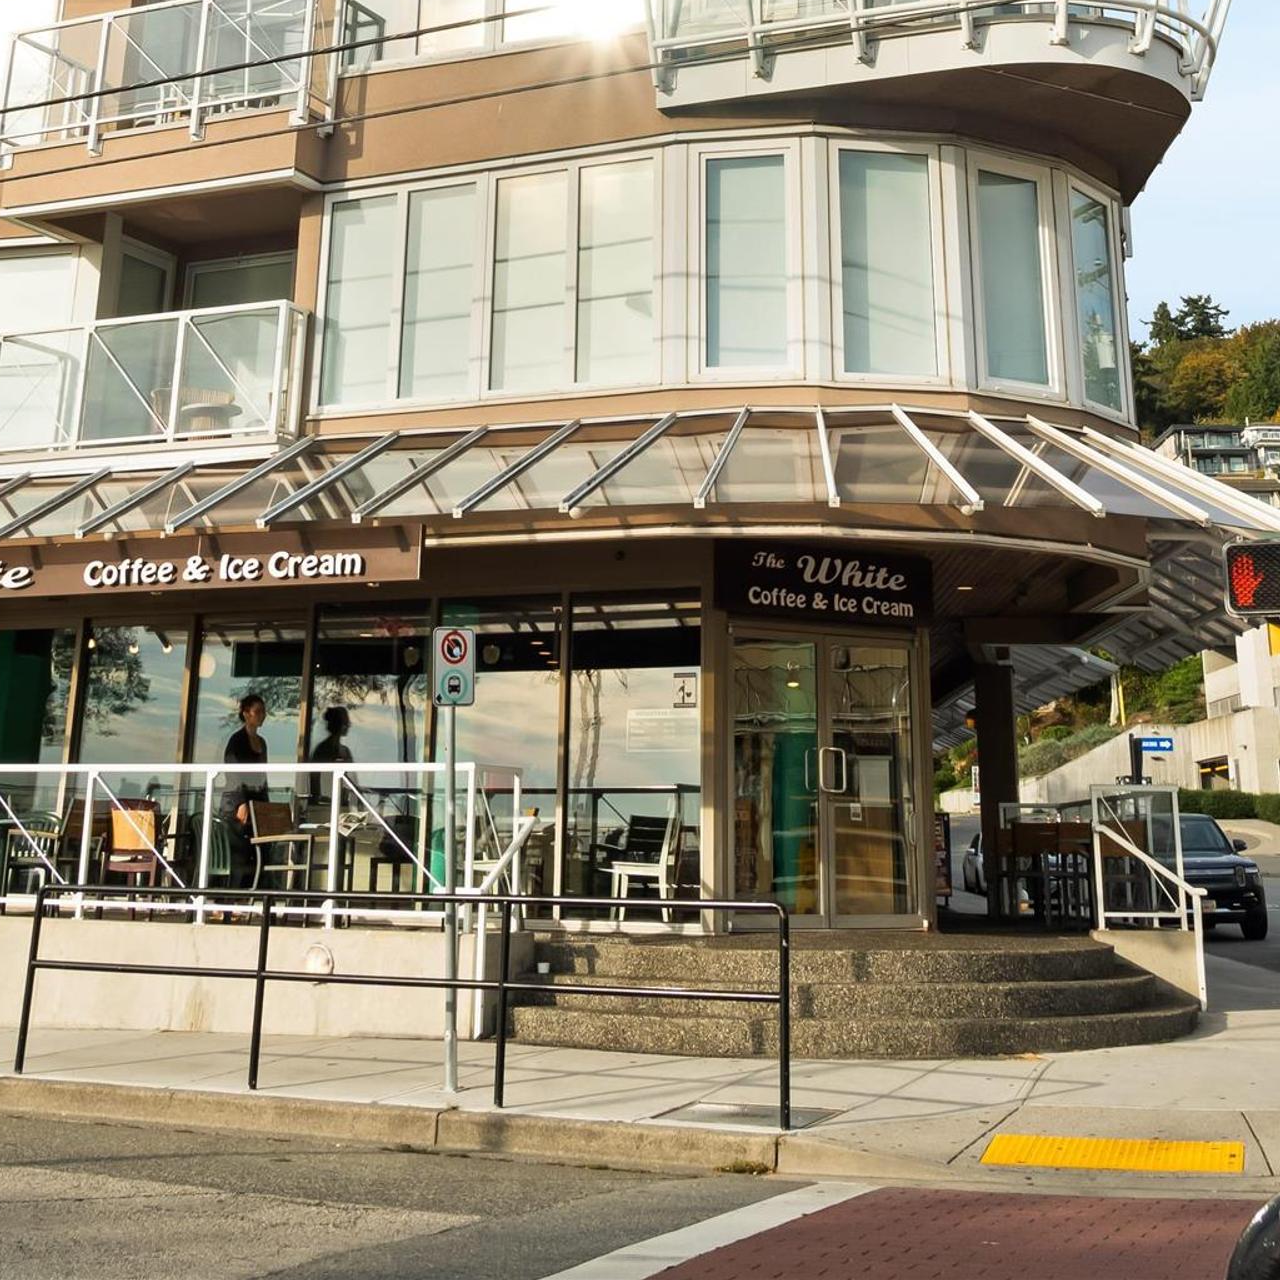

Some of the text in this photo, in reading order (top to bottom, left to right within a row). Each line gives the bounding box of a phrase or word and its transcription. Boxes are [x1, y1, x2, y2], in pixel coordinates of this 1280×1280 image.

[83, 557, 174, 587] Coffee
[182, 555, 210, 581] &
[219, 553, 259, 581] Ice
[268, 551, 362, 578] Cream
[751, 551, 907, 591] The White
[748, 586, 914, 617] Coffee & Ice Cream
